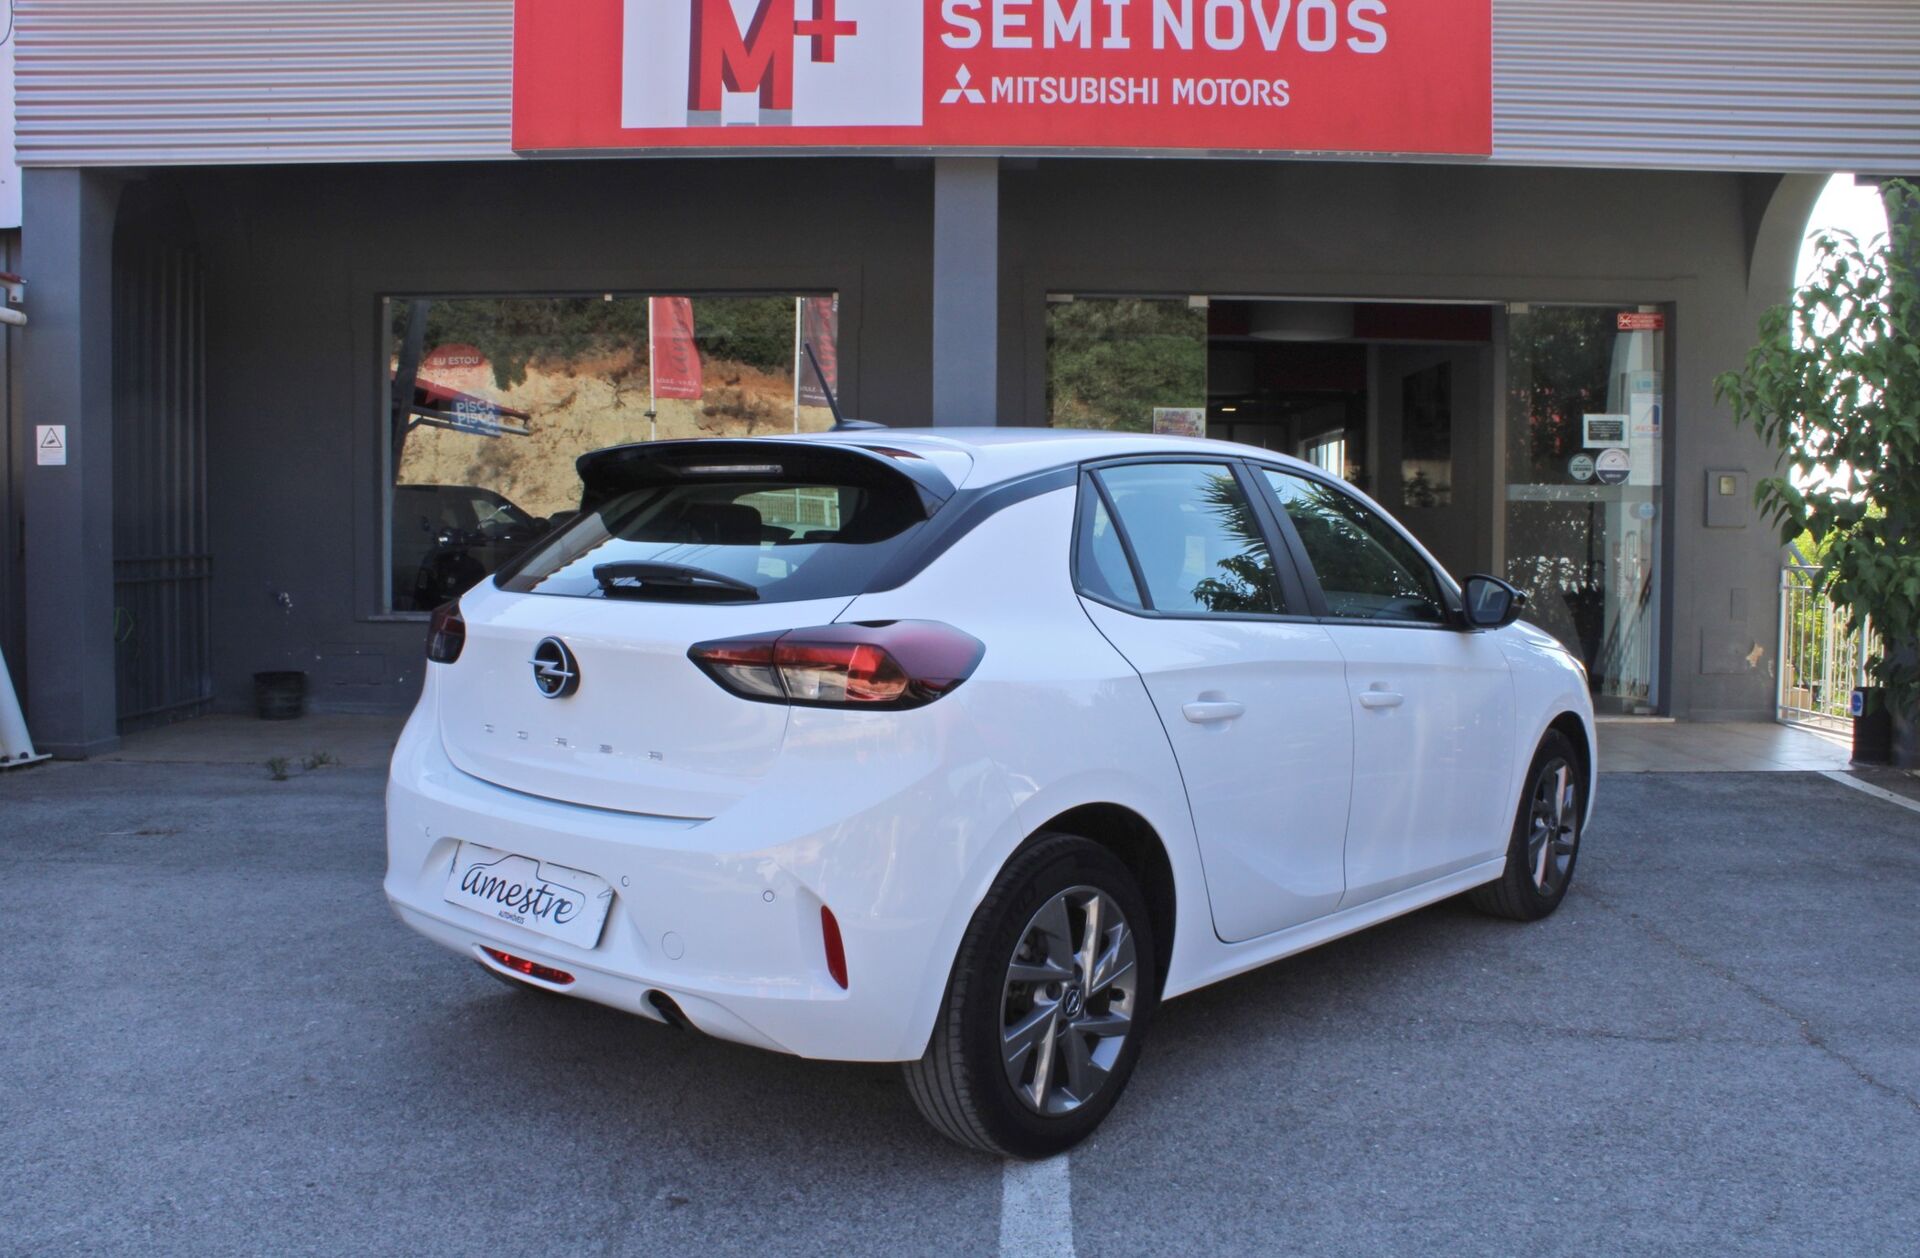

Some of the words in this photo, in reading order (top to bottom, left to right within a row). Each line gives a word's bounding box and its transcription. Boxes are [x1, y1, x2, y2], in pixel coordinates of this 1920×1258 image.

[991, 76, 1158, 104] MITSUBISHI
[1172, 78, 1290, 107] MOTORS
[448, 356, 479, 365] ESTOU
[456, 399, 496, 413] PISCA
[461, 865, 574, 924] amestre
